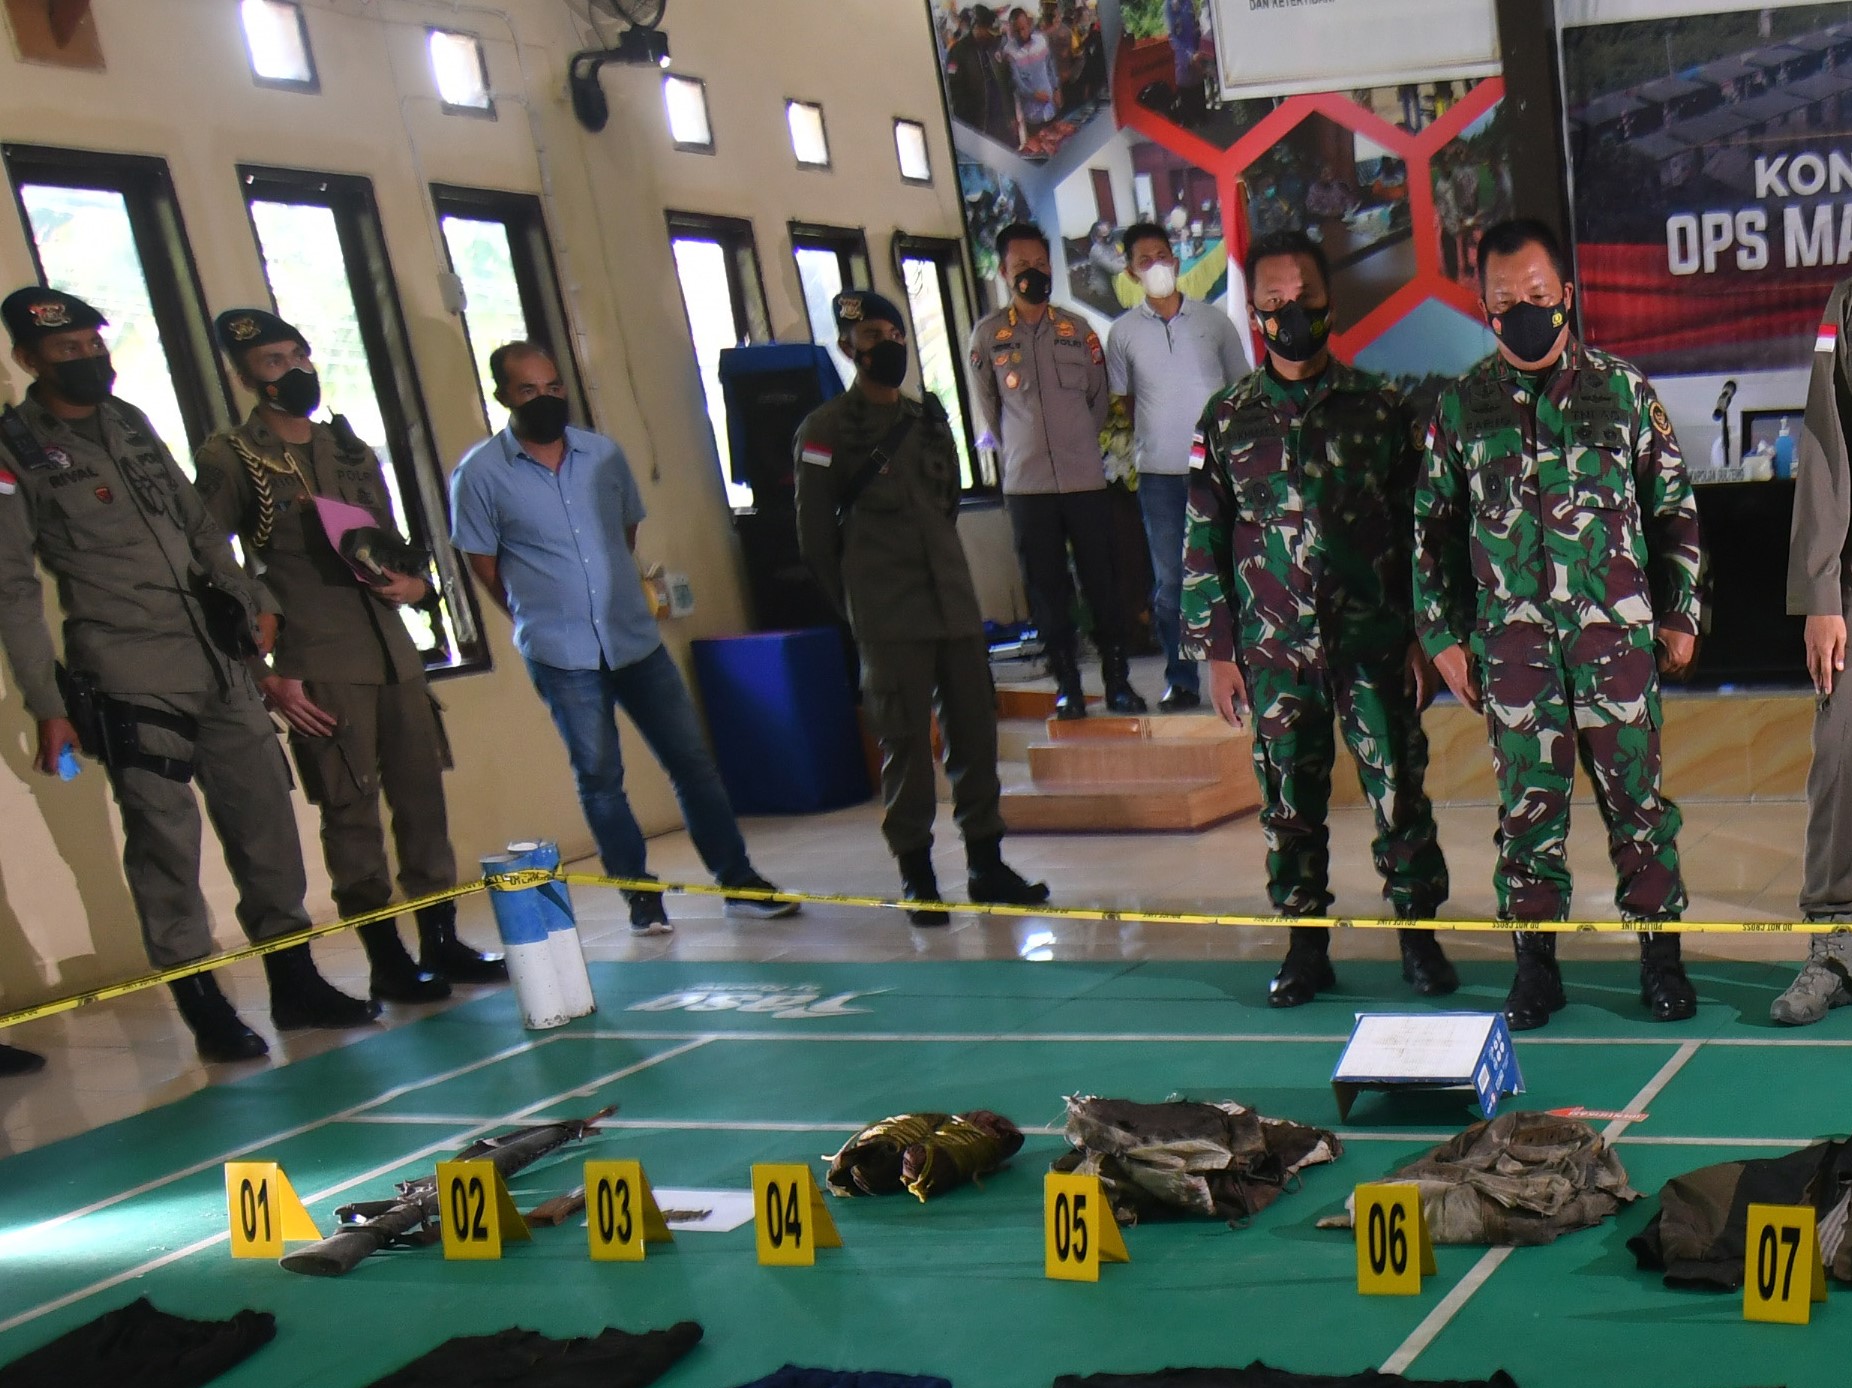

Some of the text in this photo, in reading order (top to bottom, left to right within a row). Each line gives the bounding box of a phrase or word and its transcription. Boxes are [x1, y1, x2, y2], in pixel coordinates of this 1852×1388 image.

[1666, 208, 1769, 276] OPS
[241, 1179, 270, 1242] 01
[452, 1177, 488, 1241] 02
[598, 1179, 632, 1244] 03
[767, 1182, 801, 1248] 04
[1055, 1193, 1087, 1262] 05
[1369, 1203, 1407, 1275] 06
[1758, 1225, 1800, 1301] 07
